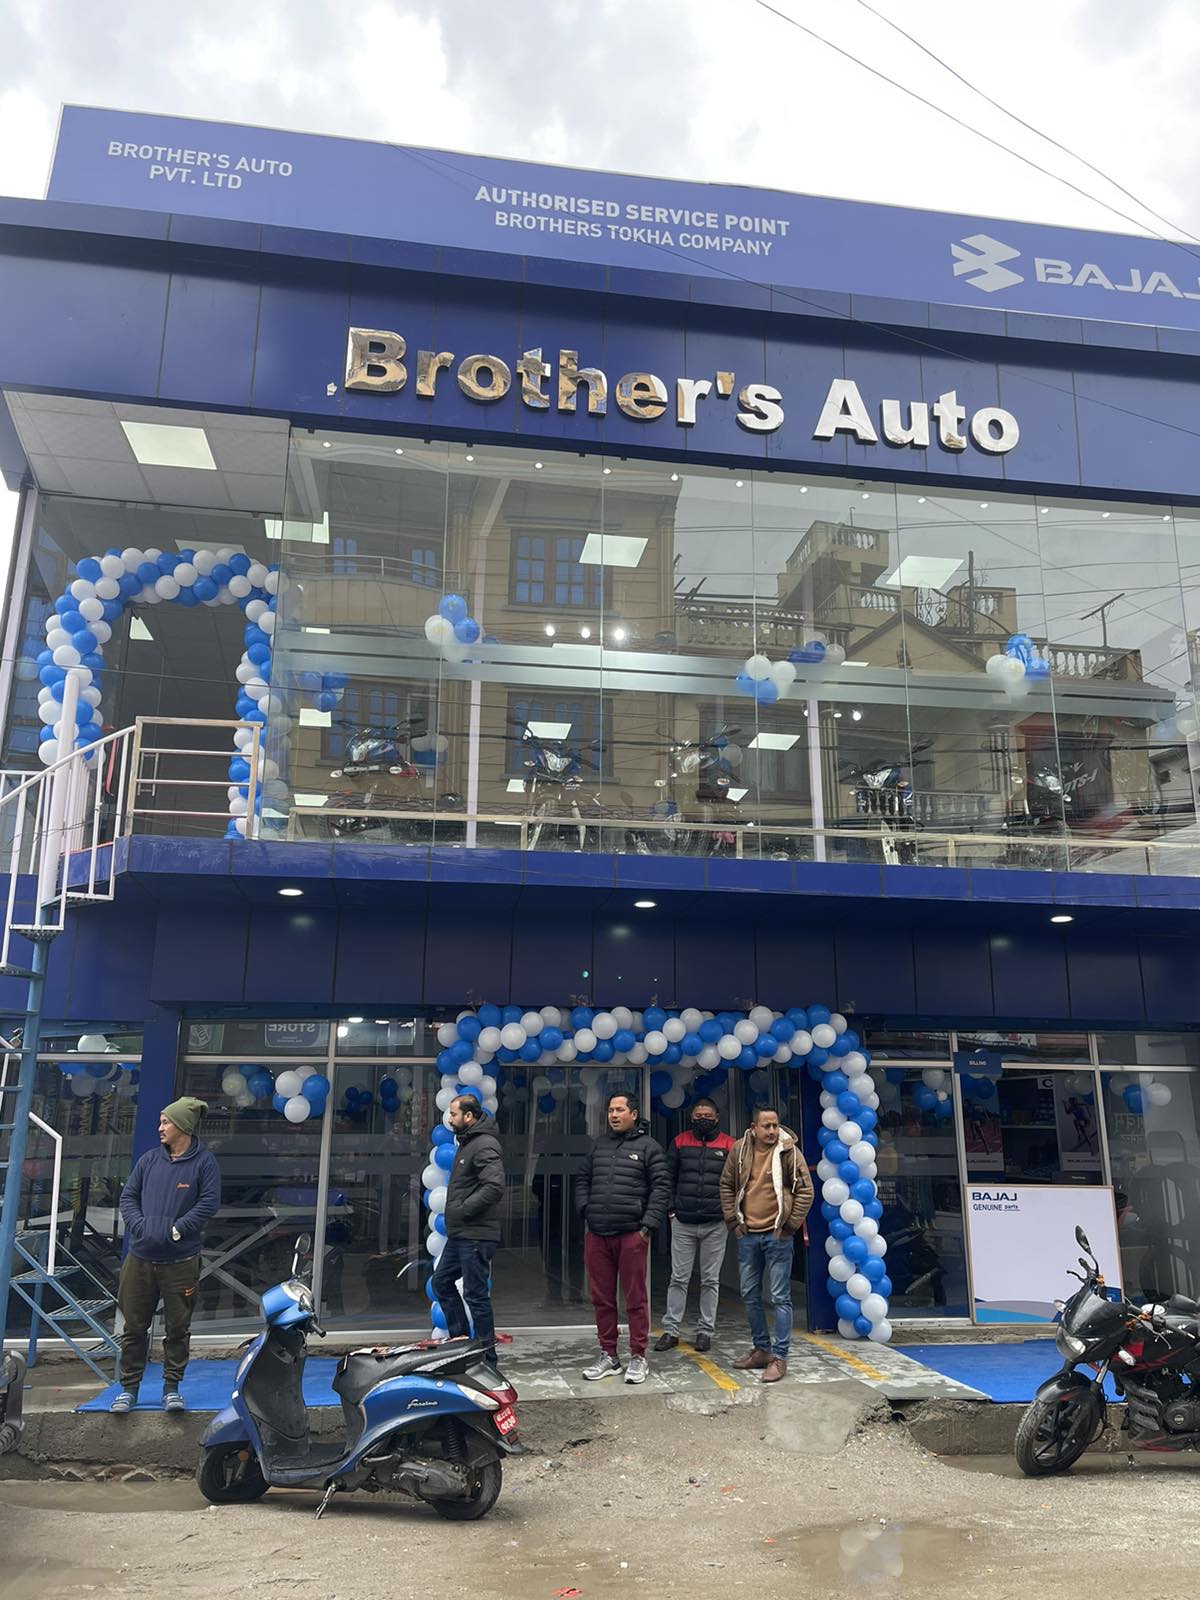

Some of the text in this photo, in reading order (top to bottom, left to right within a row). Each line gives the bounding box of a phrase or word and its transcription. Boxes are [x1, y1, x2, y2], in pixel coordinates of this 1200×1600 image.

[107, 141, 293, 177] BROTHER'S AUTO
[149, 164, 242, 190] PVT. LTD
[475, 185, 790, 237] AUTHORISED SERVICE POINT
[495, 210, 772, 256] BROTHERS TOKHA COMPANY
[344, 325, 1021, 454] Brother's Auto
[972, 1192, 1017, 1201] BAJAJ
